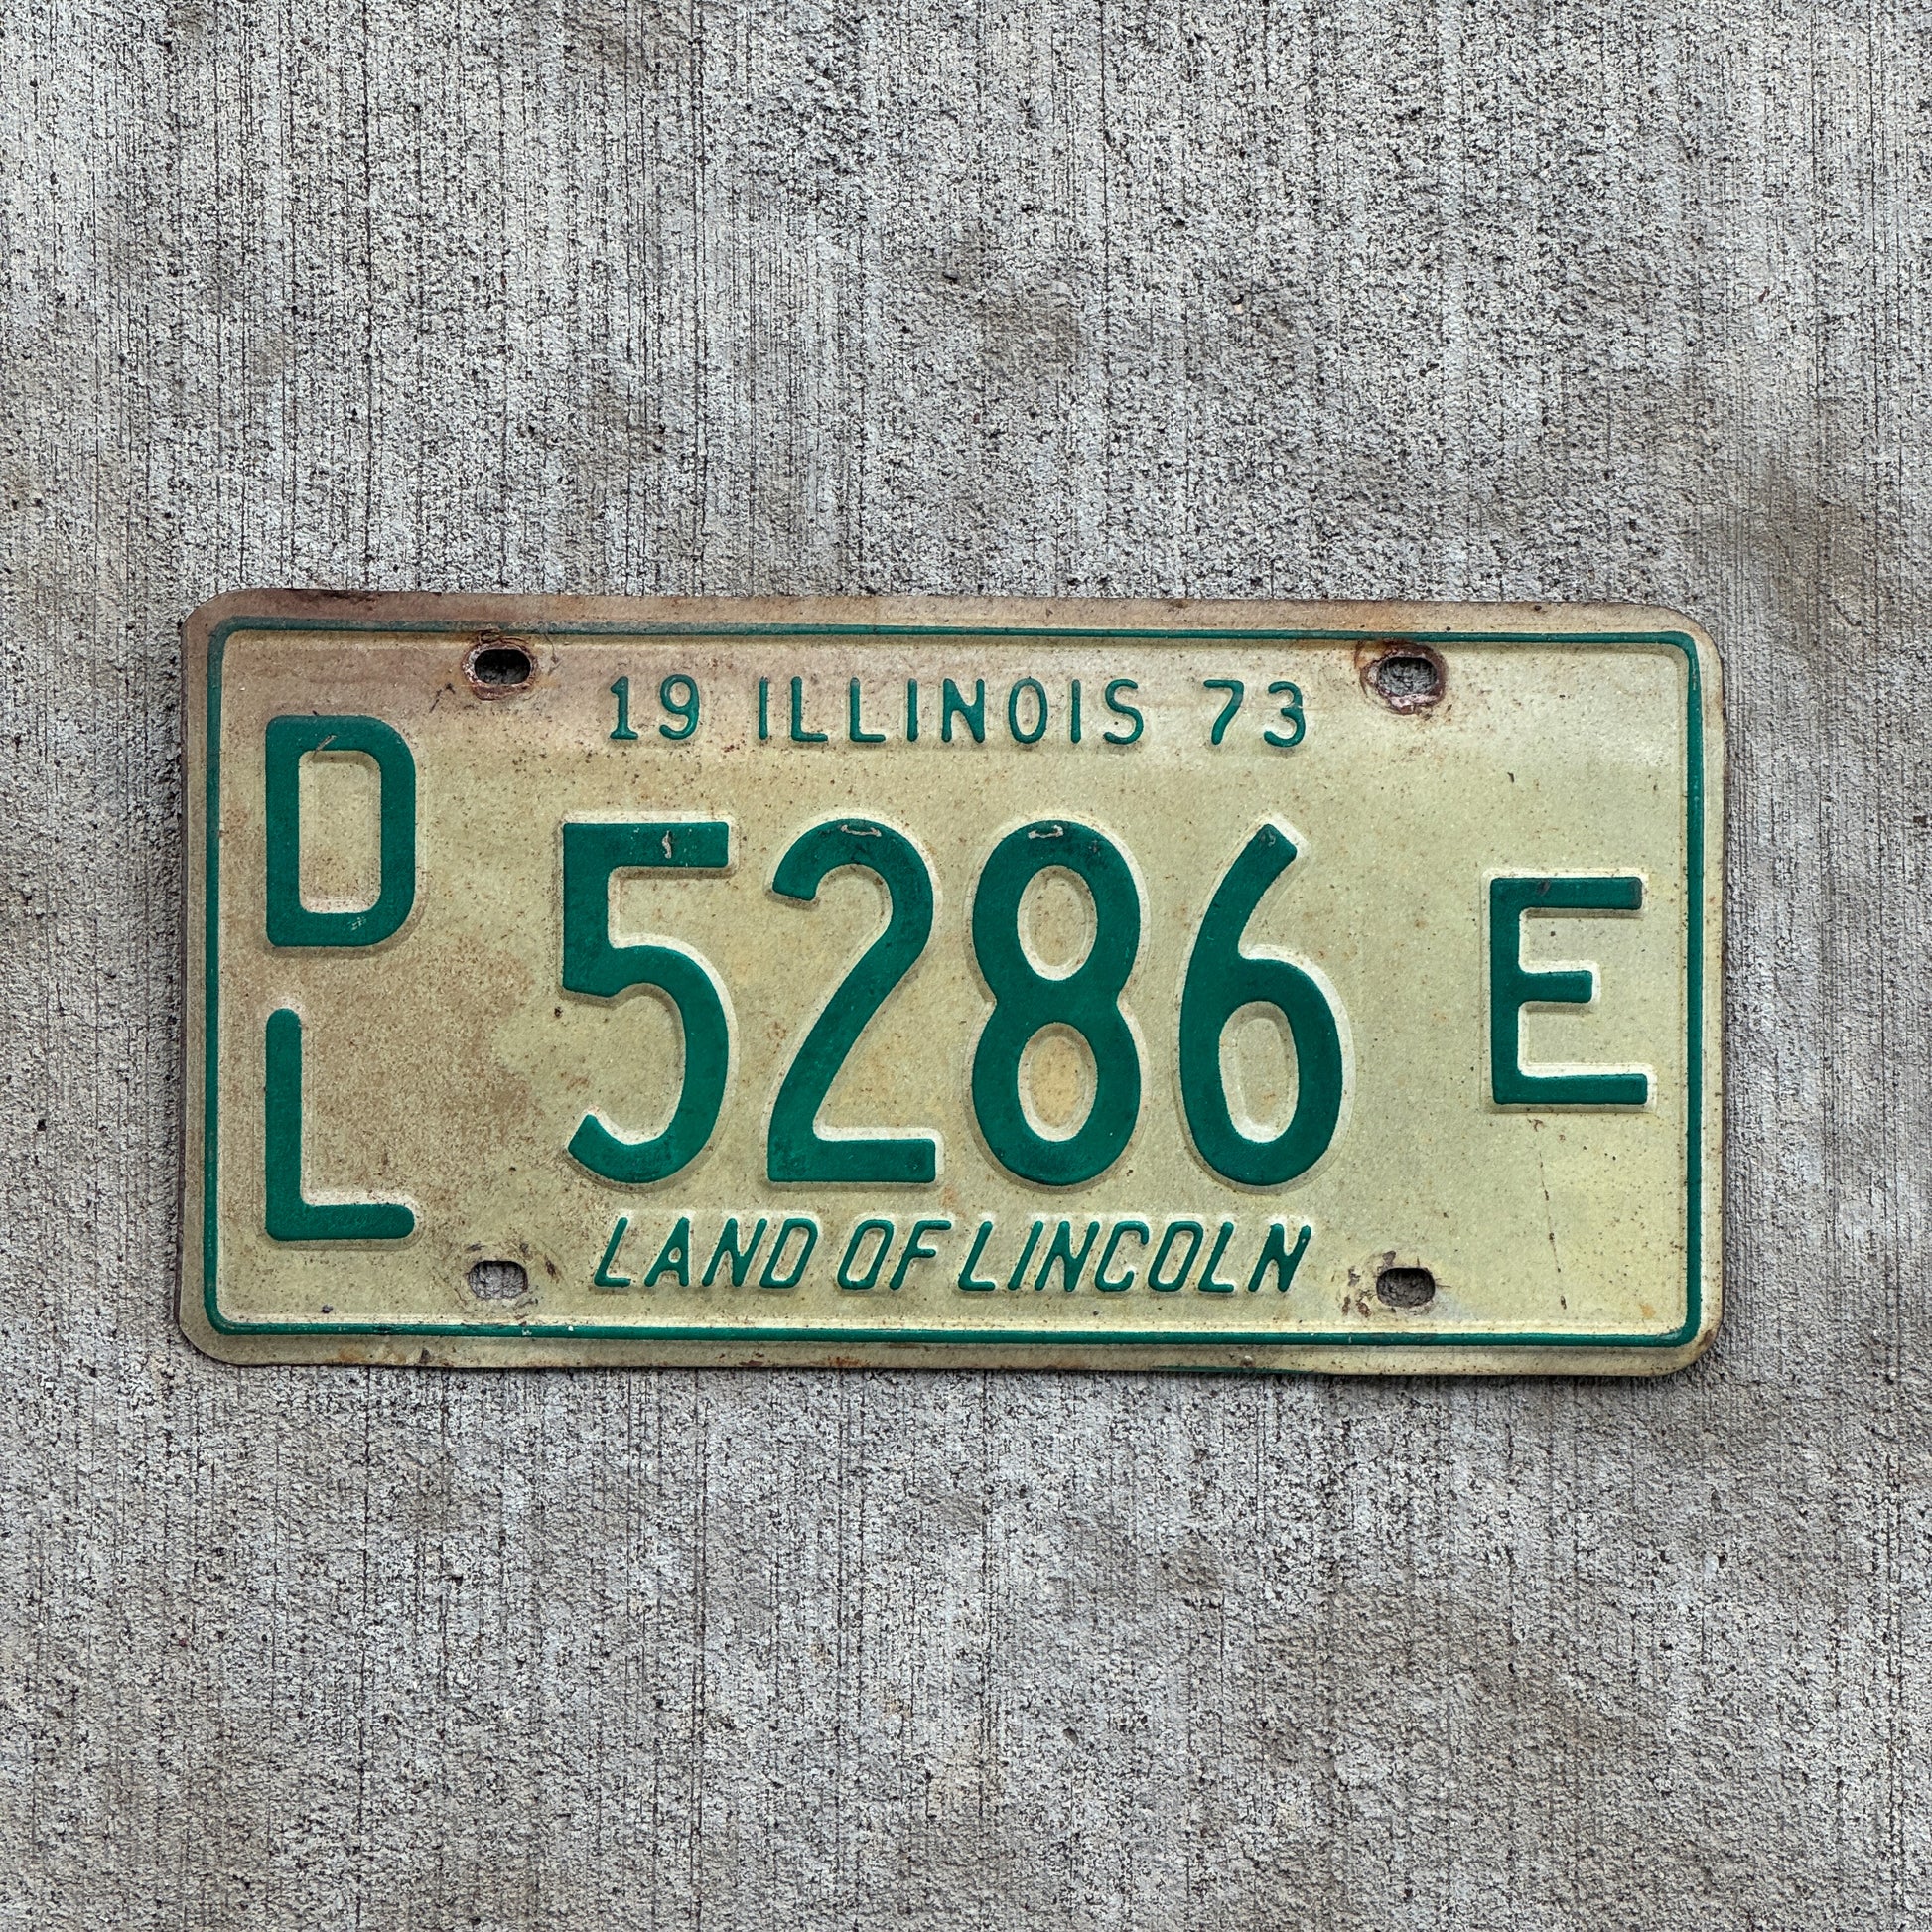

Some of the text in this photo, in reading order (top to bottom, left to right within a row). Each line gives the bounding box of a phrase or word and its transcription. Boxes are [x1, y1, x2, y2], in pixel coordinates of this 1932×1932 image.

[610, 675, 1306, 748] 19 ILLINOIS 73
[562, 817, 1343, 1188] 5286
[1489, 876, 1648, 1106] E
[593, 1216, 1312, 1294] LAND OF LINCOLN
